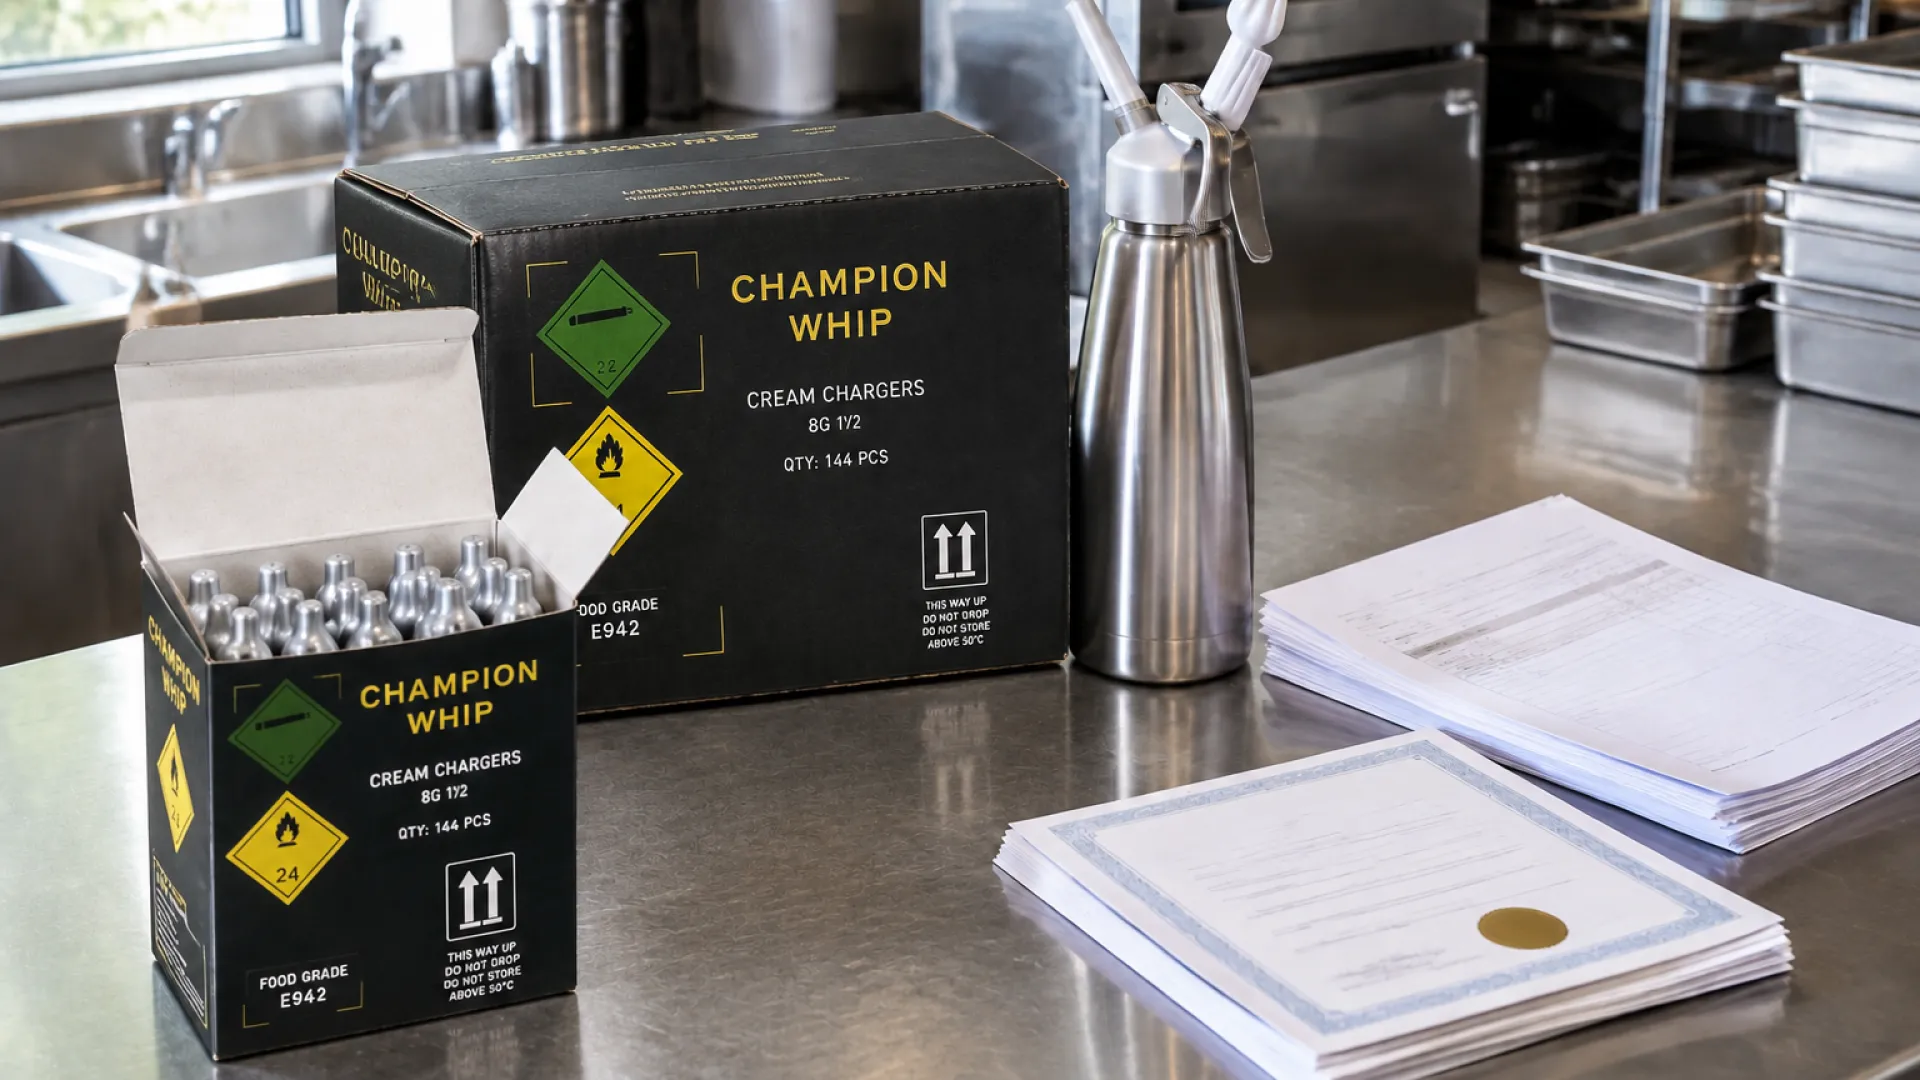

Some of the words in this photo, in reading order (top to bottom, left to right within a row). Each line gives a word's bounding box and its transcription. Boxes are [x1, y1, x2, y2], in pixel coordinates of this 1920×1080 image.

[731, 260, 947, 303] CHAMPION
[789, 308, 892, 342] WHIP
[597, 360, 616, 374] 22
[747, 387, 815, 409] CREAM
[823, 379, 925, 403] CHARGERS
[808, 416, 831, 433] 8G
[784, 456, 819, 472] QTY:
[825, 453, 852, 468] 144
[858, 449, 888, 466] PCS
[612, 597, 659, 613] GRADE
[925, 600, 947, 610] THIS
[949, 597, 971, 608] WAY
[974, 596, 987, 606] UP
[923, 614, 937, 624] DO
[939, 611, 959, 622] NOT
[962, 609, 989, 620] DROP
[591, 620, 640, 640] E942
[922, 626, 936, 636] DO
[938, 624, 957, 635] NOT
[960, 621, 991, 633] STORE
[927, 637, 960, 649] ABOVE
[148, 614, 200, 706] CHAMPION
[161, 665, 187, 716] WHIP
[360, 659, 538, 709] CHAMPION
[407, 700, 494, 735] WHIP
[369, 765, 429, 788] CREAM
[434, 750, 521, 777] CHARGERS
[421, 788, 441, 804] 8G
[398, 825, 430, 840] QTY:
[435, 819, 459, 834] 144
[464, 813, 491, 829] PCS
[276, 866, 300, 883] 24
[447, 949, 473, 963] THIS
[475, 944, 499, 957] WAY
[502, 941, 516, 952] UP
[444, 965, 462, 977] DO
[465, 959, 487, 972] NOT
[491, 953, 521, 967] DROP
[259, 971, 297, 990] FOOD
[301, 964, 349, 983] GRADE
[444, 978, 460, 990] DO
[463, 974, 484, 986] NOT
[488, 965, 522, 981] STORE
[280, 986, 326, 1009] E942
[449, 985, 486, 1001] ABOVE
